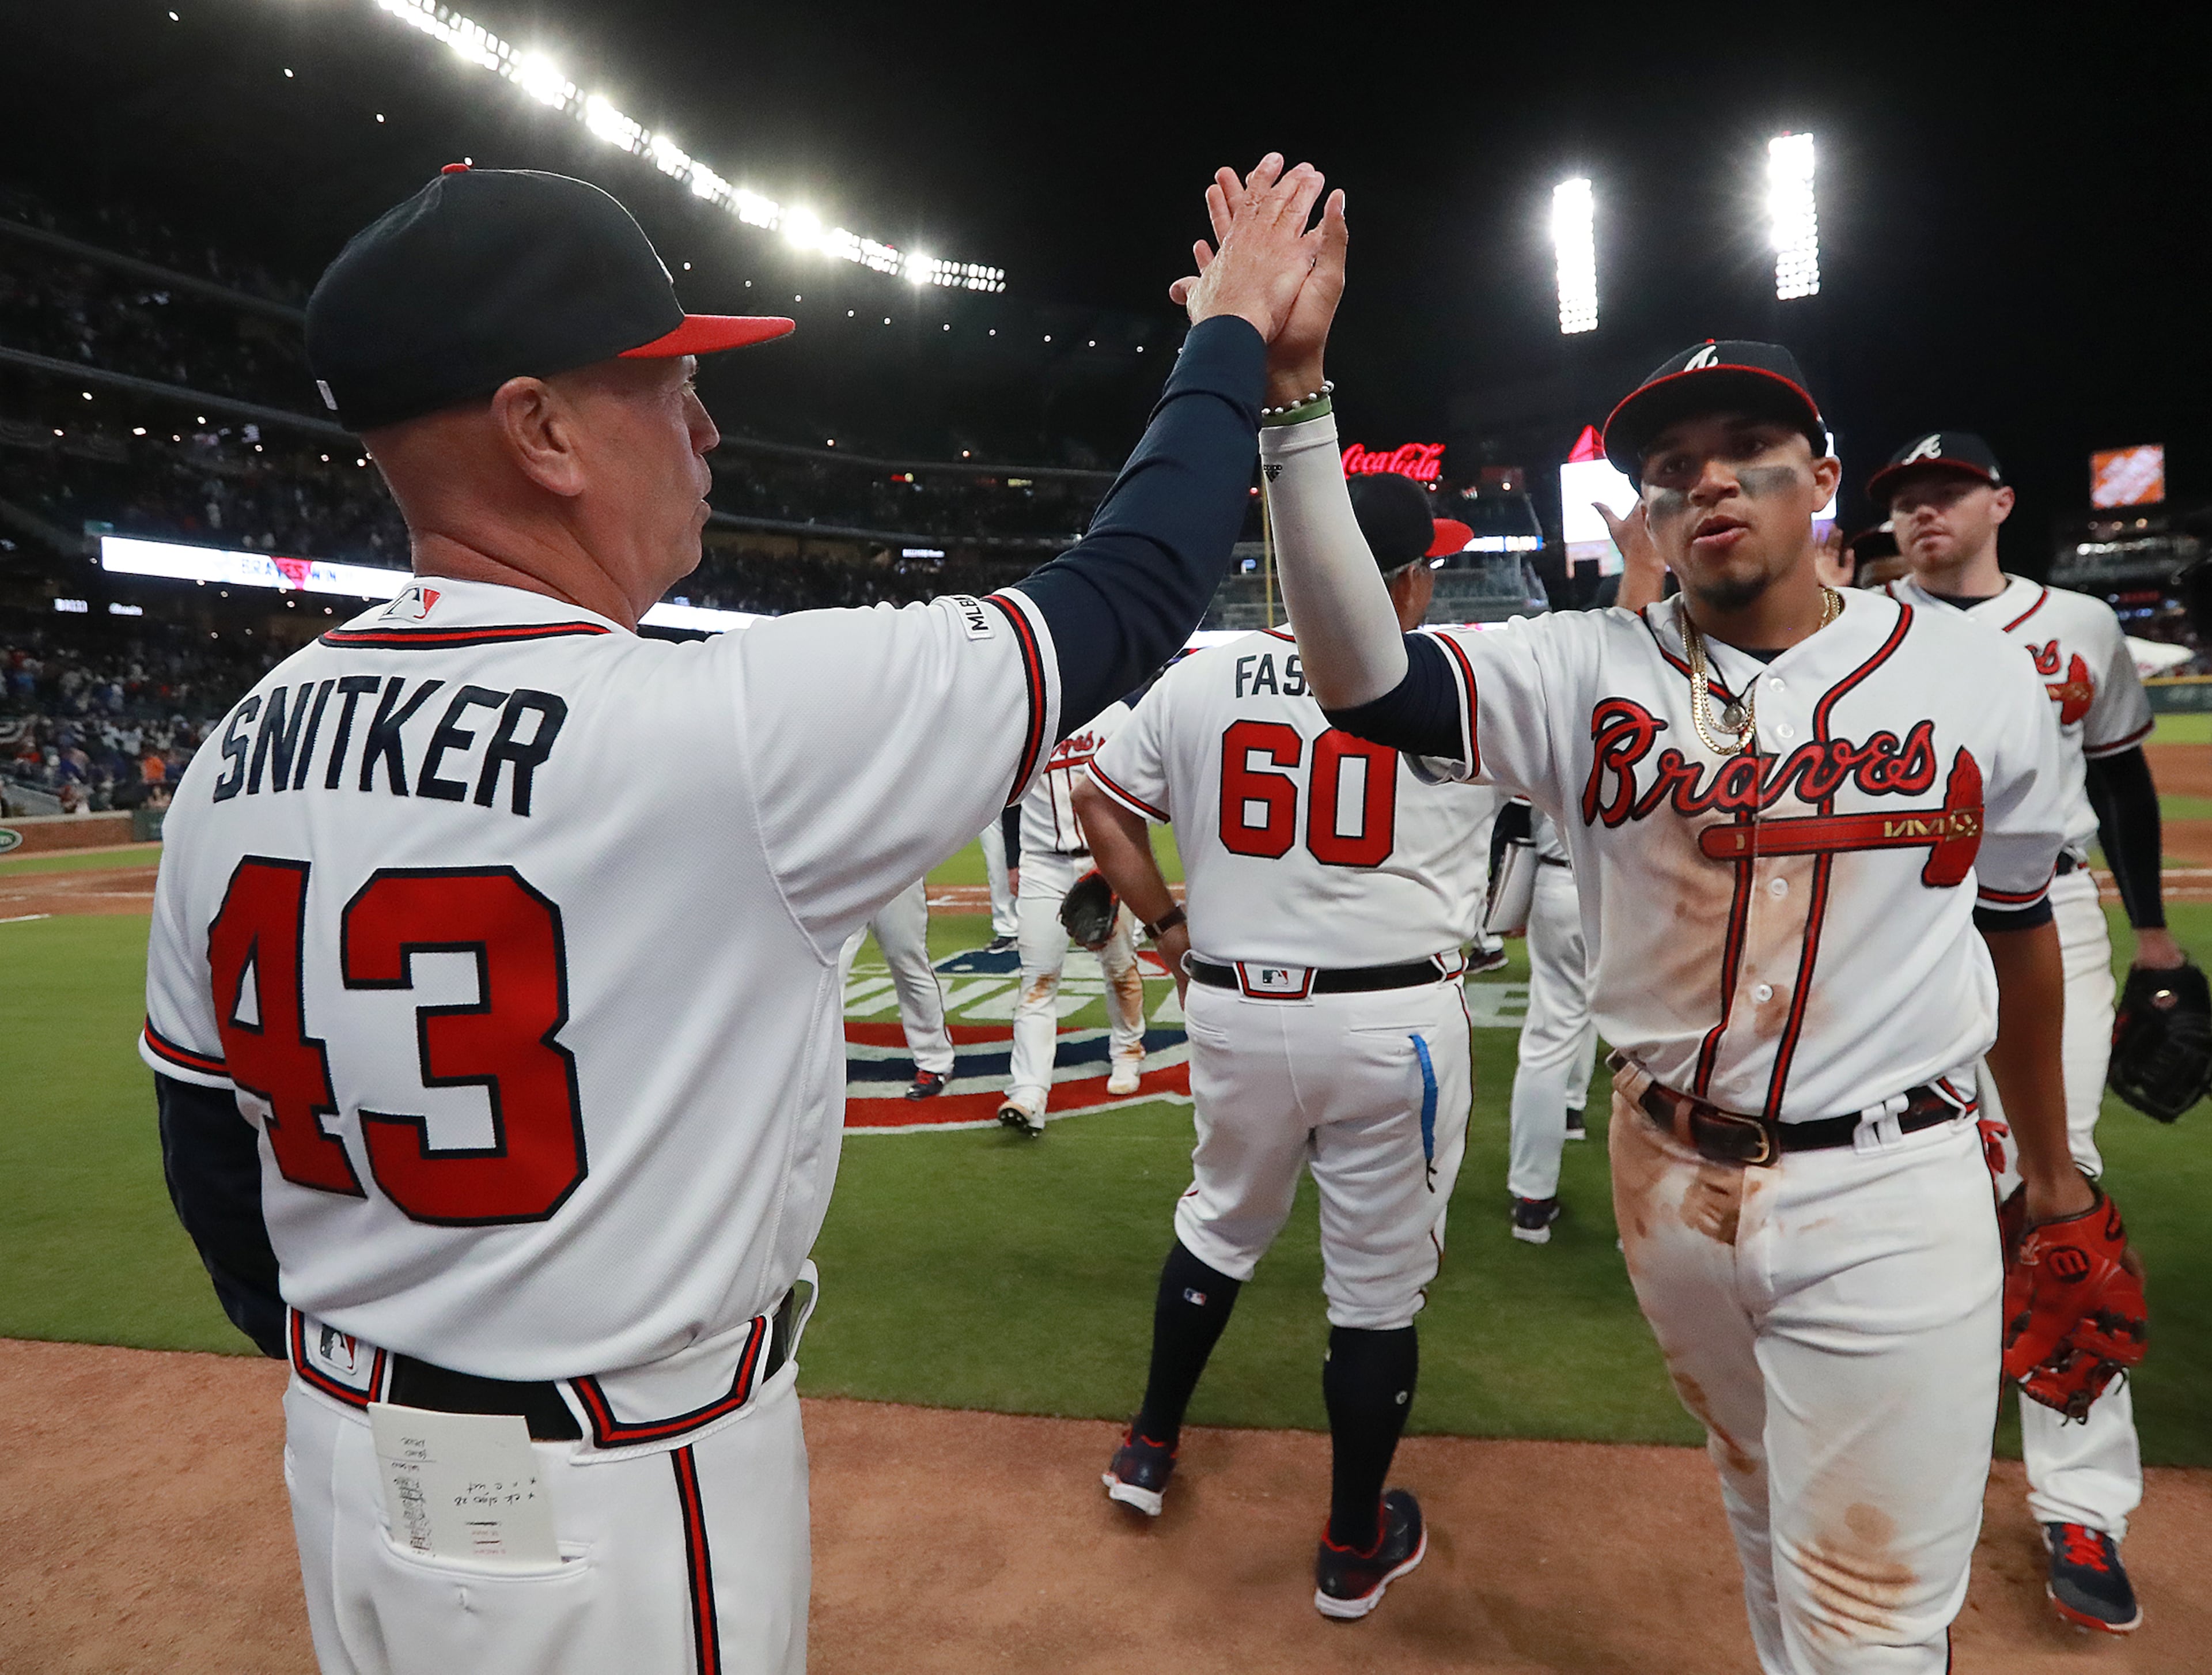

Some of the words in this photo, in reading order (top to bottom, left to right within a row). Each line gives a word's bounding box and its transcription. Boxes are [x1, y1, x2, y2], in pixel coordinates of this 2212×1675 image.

[213, 675, 568, 817] SNITKER
[1236, 653, 1313, 698] FAS
[1219, 719, 1398, 868] 60
[1582, 697, 1936, 829] Braves
[206, 854, 588, 1227] 43
